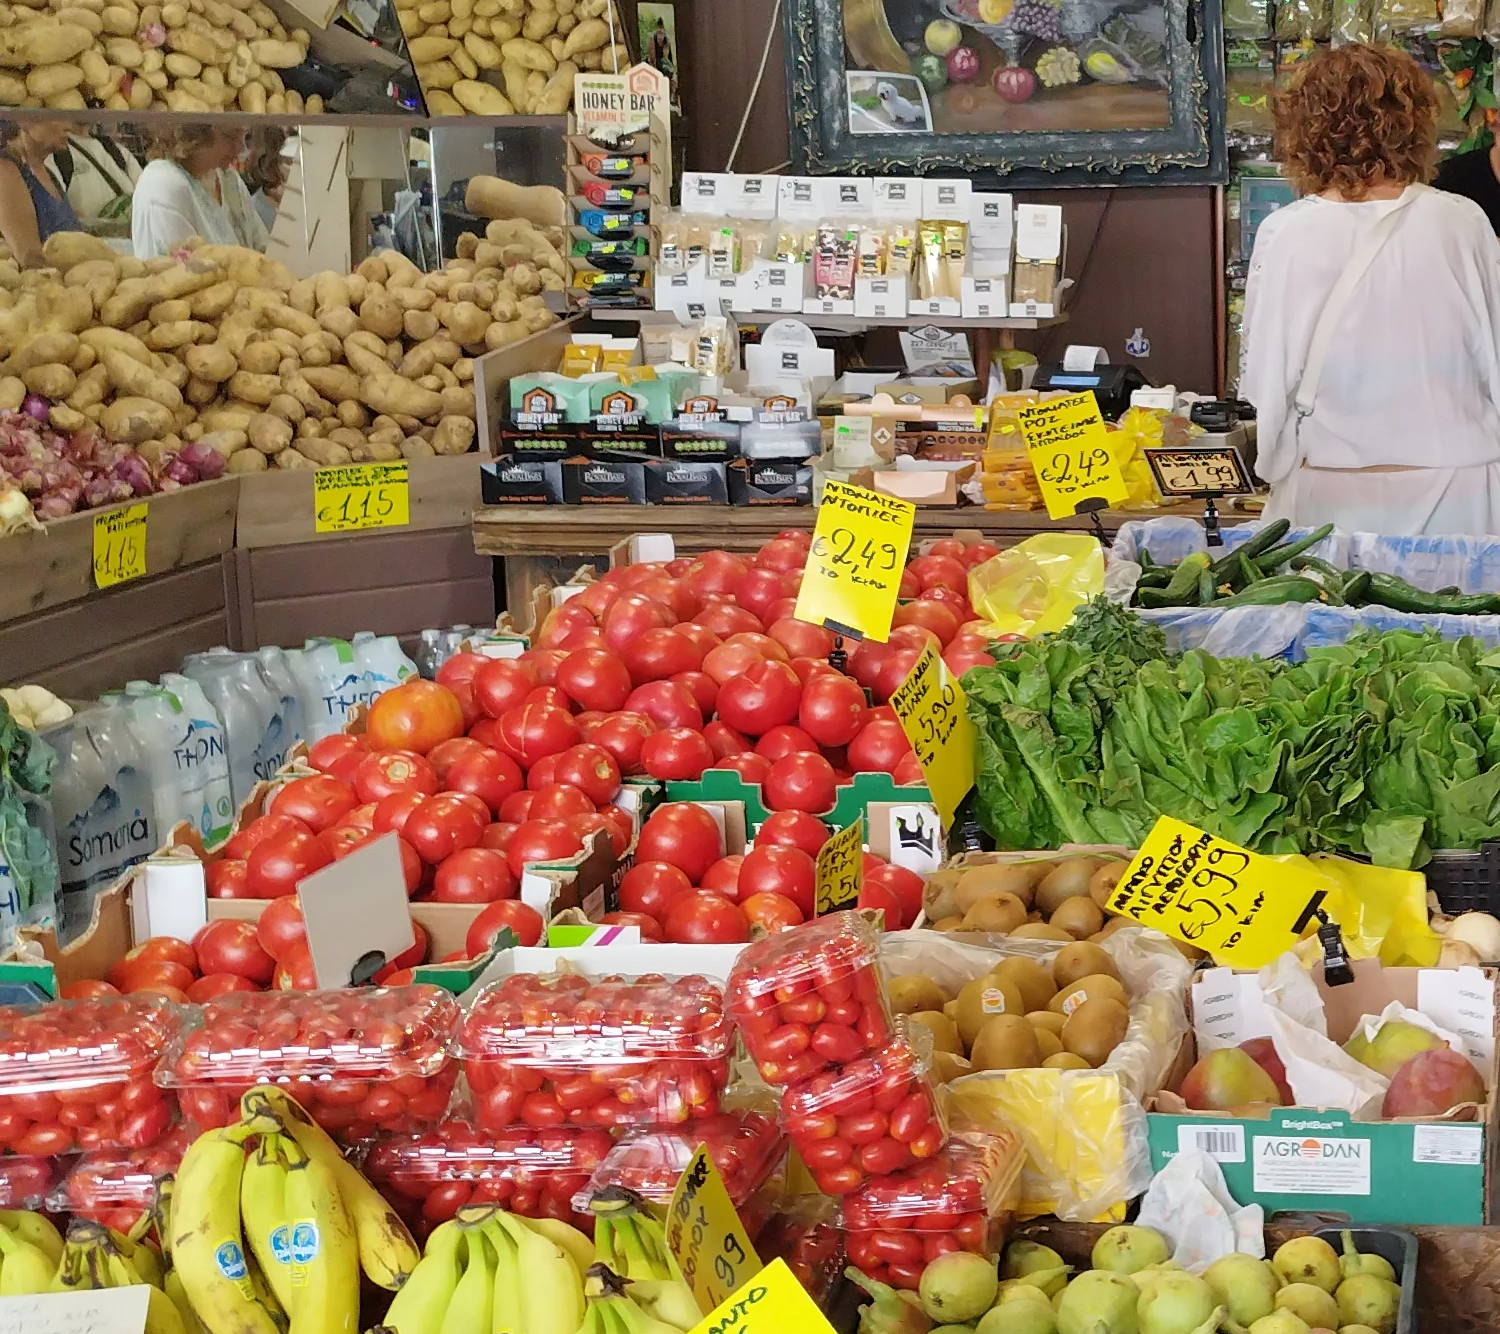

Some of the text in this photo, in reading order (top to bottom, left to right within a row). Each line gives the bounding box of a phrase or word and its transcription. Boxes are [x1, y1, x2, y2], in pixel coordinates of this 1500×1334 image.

[582, 92, 625, 110] HONEY
[1041, 448, 1110, 484] €2,49
[318, 488, 394, 525] €1,15
[812, 528, 897, 574] €2,49
[1175, 848, 1251, 940] €5,99
[1263, 1139, 1361, 1159] AGRODAN
